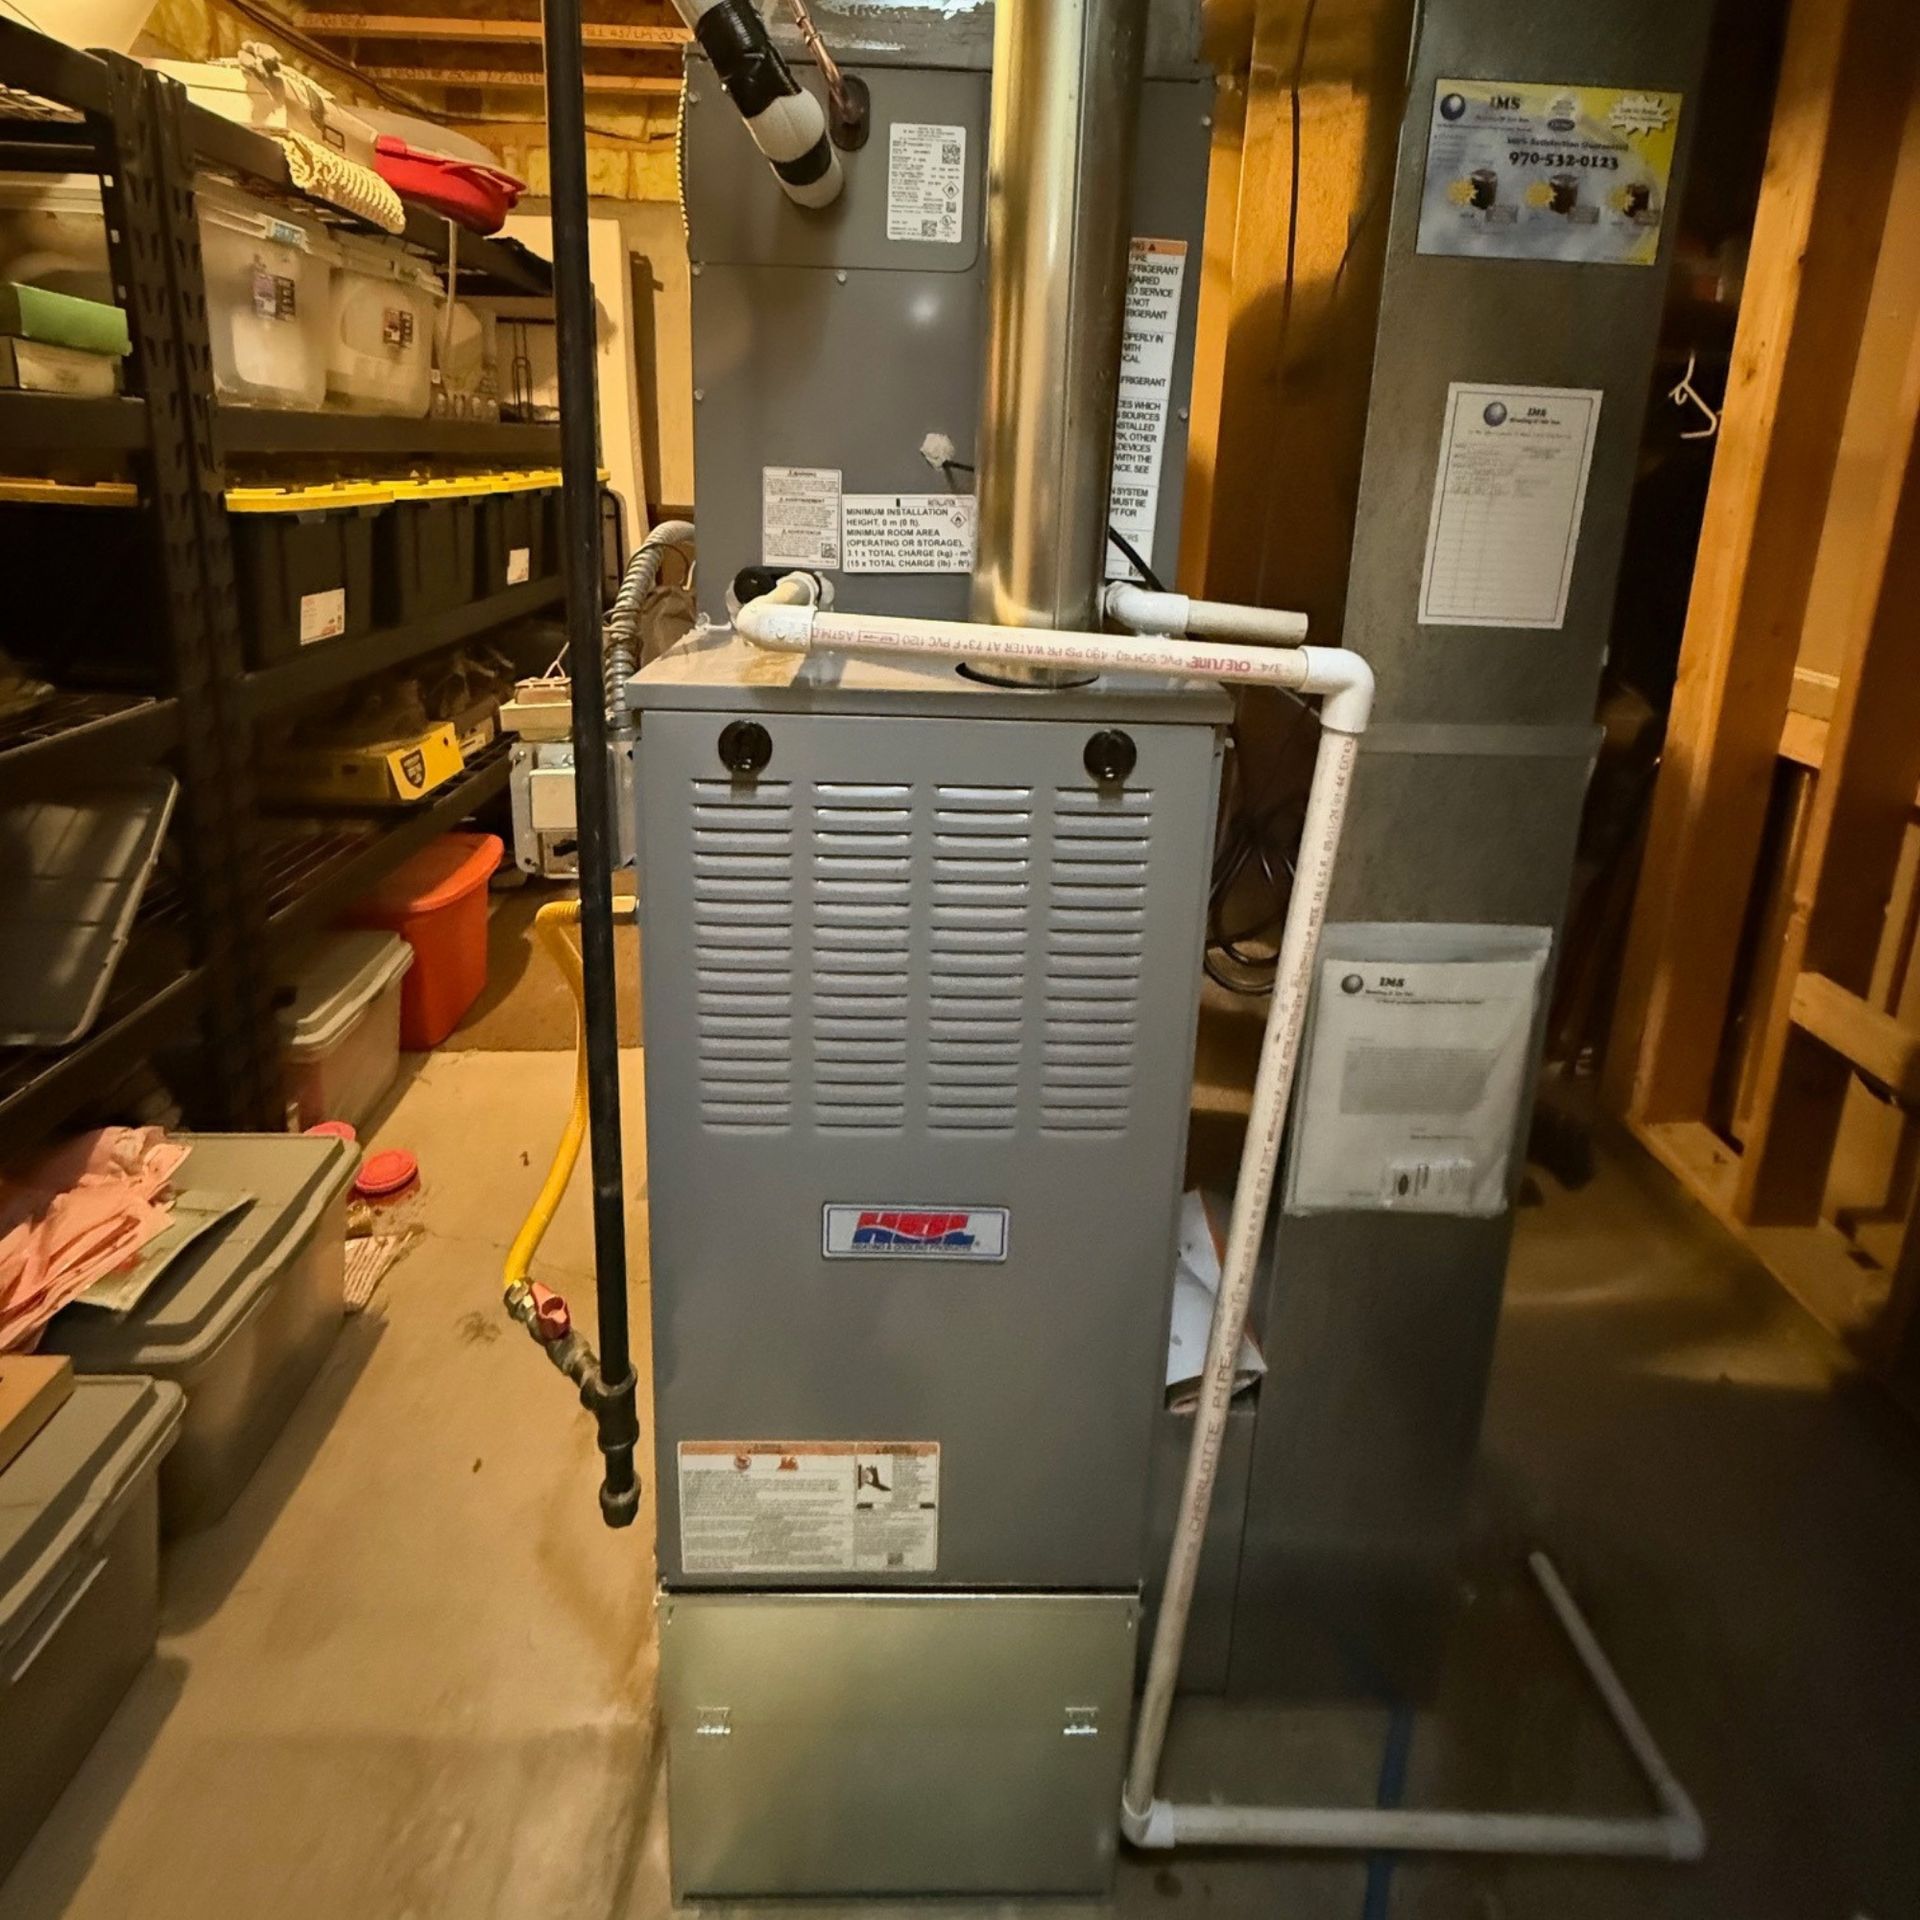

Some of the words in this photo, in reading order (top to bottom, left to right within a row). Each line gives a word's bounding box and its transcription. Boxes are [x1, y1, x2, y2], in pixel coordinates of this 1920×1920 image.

[1508, 151, 1620, 171] 970-532-0123
[1140, 287, 1174, 298] SERVICE
[1133, 298, 1150, 308] NOT
[1134, 401, 1161, 411] WHICH
[1121, 411, 1161, 422] SOURCES
[1129, 432, 1158, 443] OTHER
[1133, 464, 1150, 474] SEE
[1117, 487, 1149, 498] SYSTEM
[1112, 497, 1134, 508] MUST
[1135, 498, 1146, 508] BE
[846, 508, 885, 516] MINIMUM
[887, 508, 949, 517] INSTALLATION
[1119, 508, 1138, 518] FOR
[846, 529, 885, 537] MINIMUM
[887, 529, 914, 537] ROOM
[916, 529, 941, 537] AREA
[846, 539, 900, 548] (OPERATING
[901, 539, 915, 547] OR
[868, 549, 896, 558] TOTAL
[897, 549, 935, 558] CHARGE
[937, 549, 954, 560] (kg)
[868, 559, 896, 568] TOTAL
[897, 559, 936, 568] CHARGE
[928, 636, 951, 649] PVC
[986, 641, 1001, 653] AT
[1004, 643, 1044, 655] WATER
[1188, 1422, 1220, 1531] CHARLOTTE
[1211, 1357, 1232, 1407] PIPE
